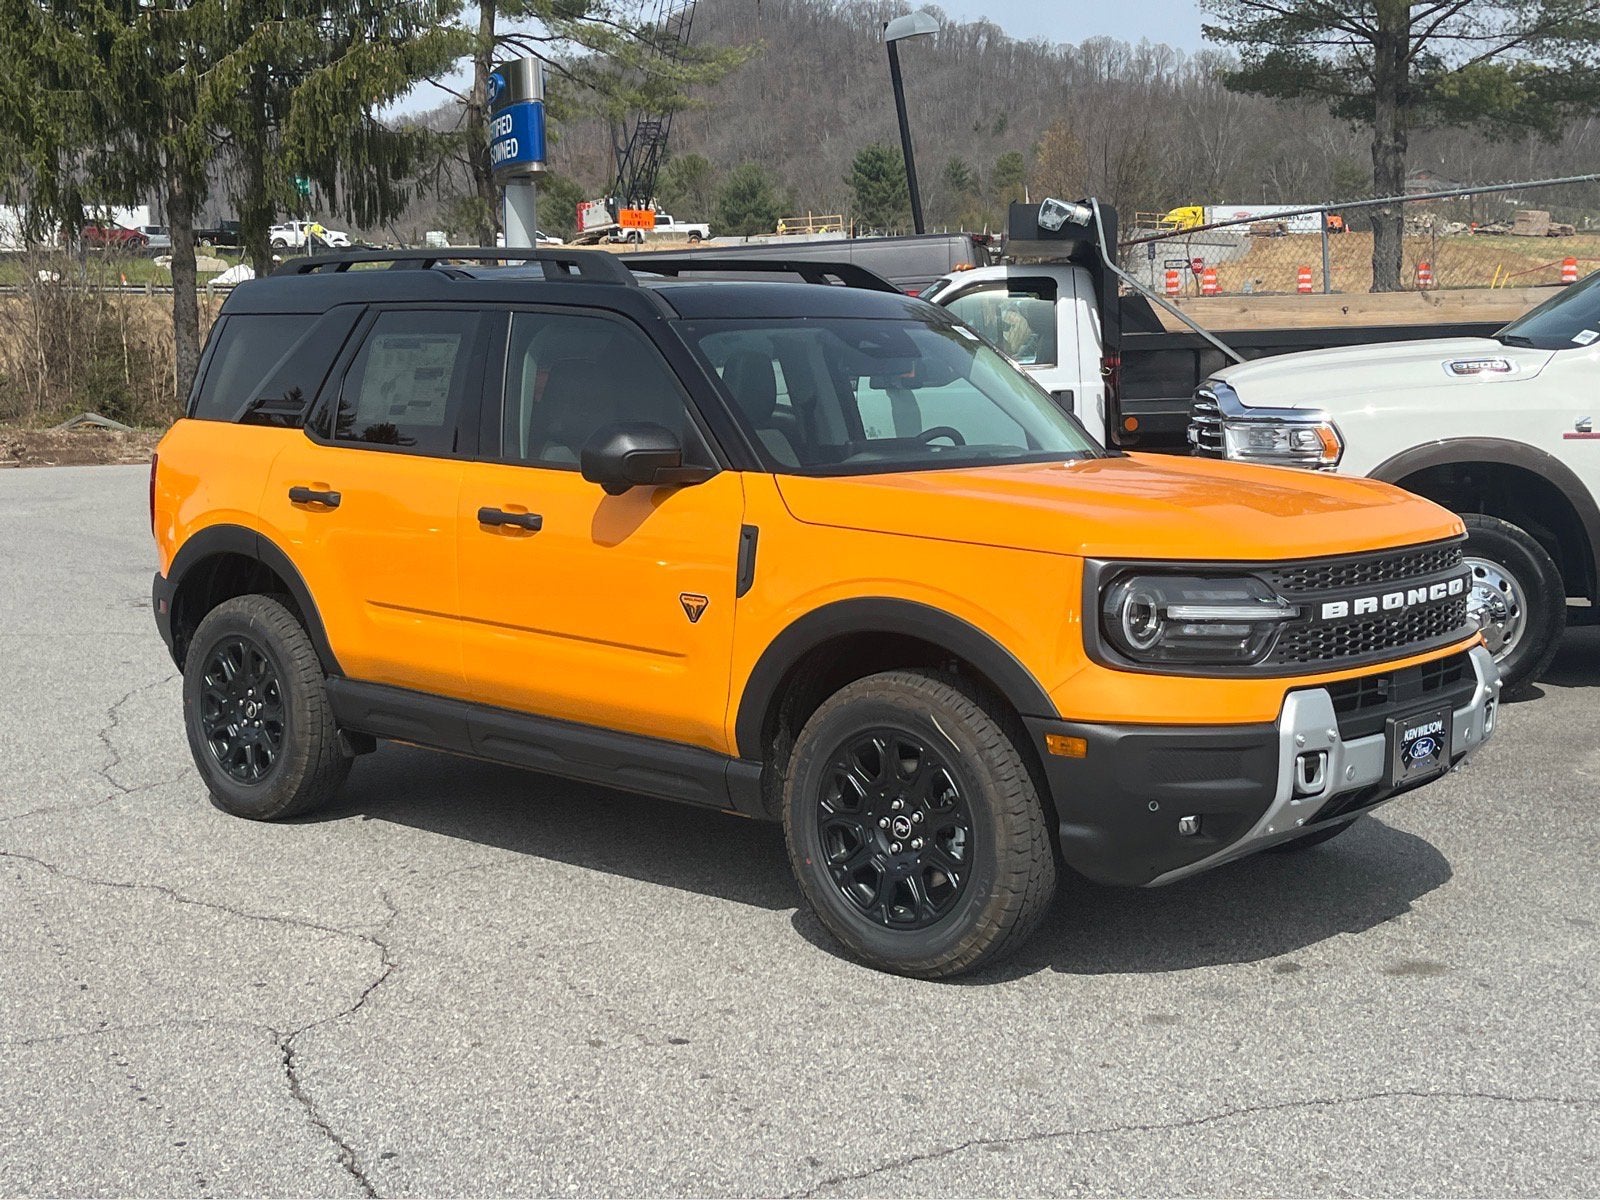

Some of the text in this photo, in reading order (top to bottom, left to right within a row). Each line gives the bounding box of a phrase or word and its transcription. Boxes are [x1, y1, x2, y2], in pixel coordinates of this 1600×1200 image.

[489, 113, 513, 139] TIFIED
[489, 137, 519, 165] -OWNED
[1321, 578, 1464, 620] BRONCO
[1404, 720, 1442, 741] KEN WILSON
[1414, 740, 1431, 757] Ford
